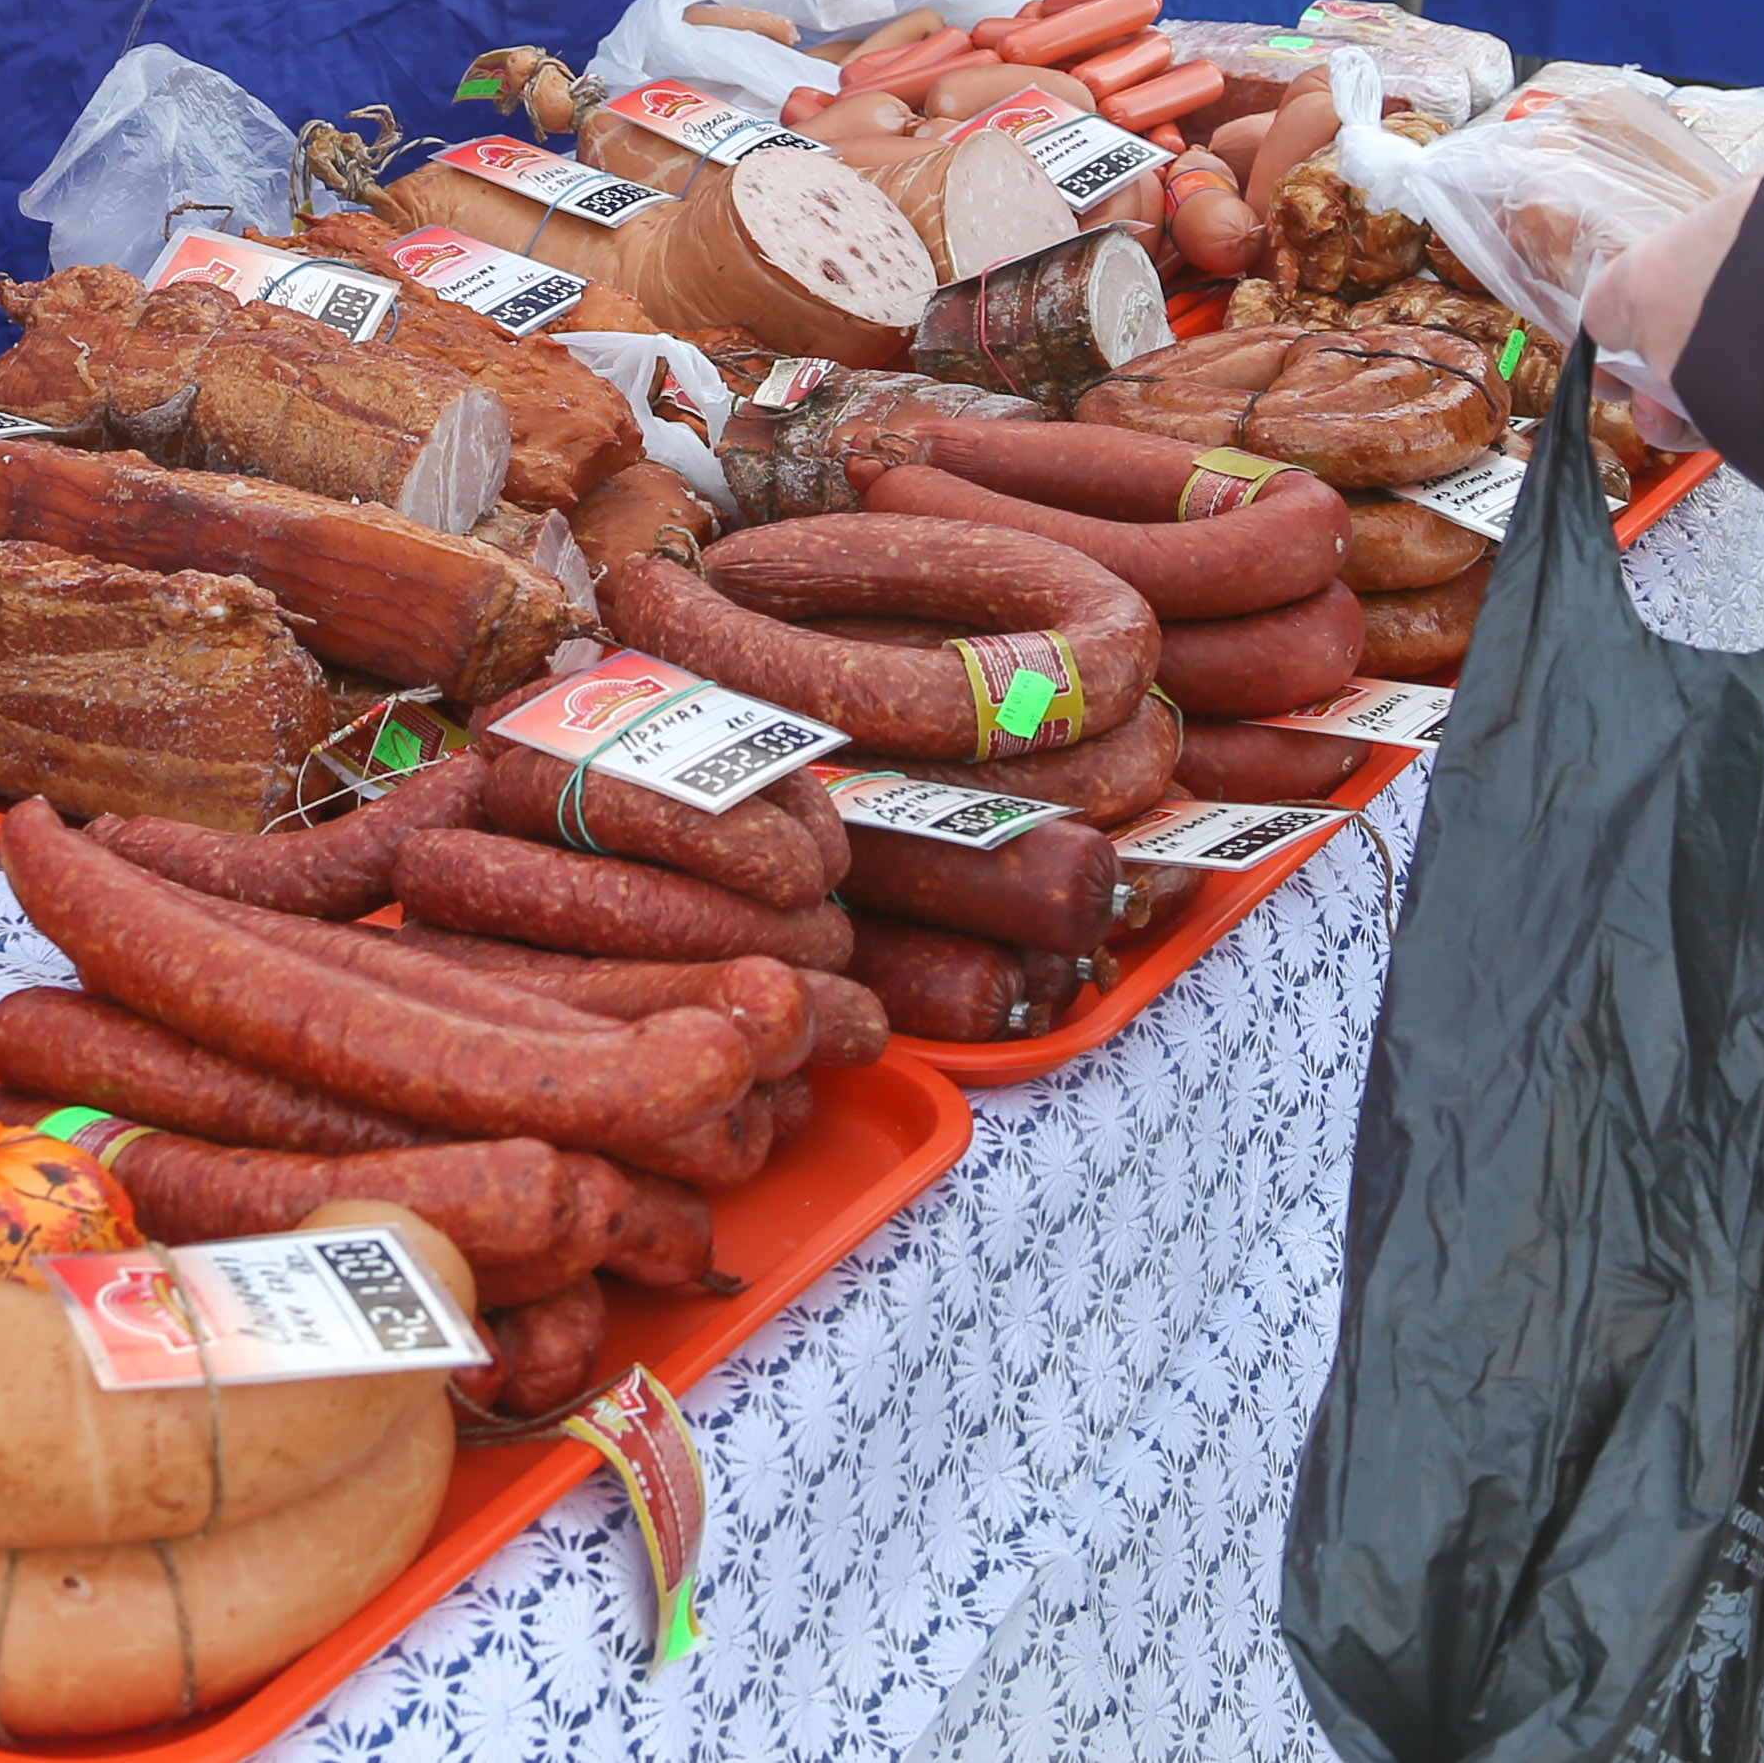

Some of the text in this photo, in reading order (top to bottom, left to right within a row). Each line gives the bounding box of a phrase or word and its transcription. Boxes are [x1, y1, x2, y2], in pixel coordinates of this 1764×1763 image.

[1062, 141, 1151, 196] 342.00
[491, 277, 583, 322] 457.00
[683, 723, 817, 793] 332.00
[1208, 812, 1324, 859] 441.00
[325, 1240, 430, 1350] 421.00
